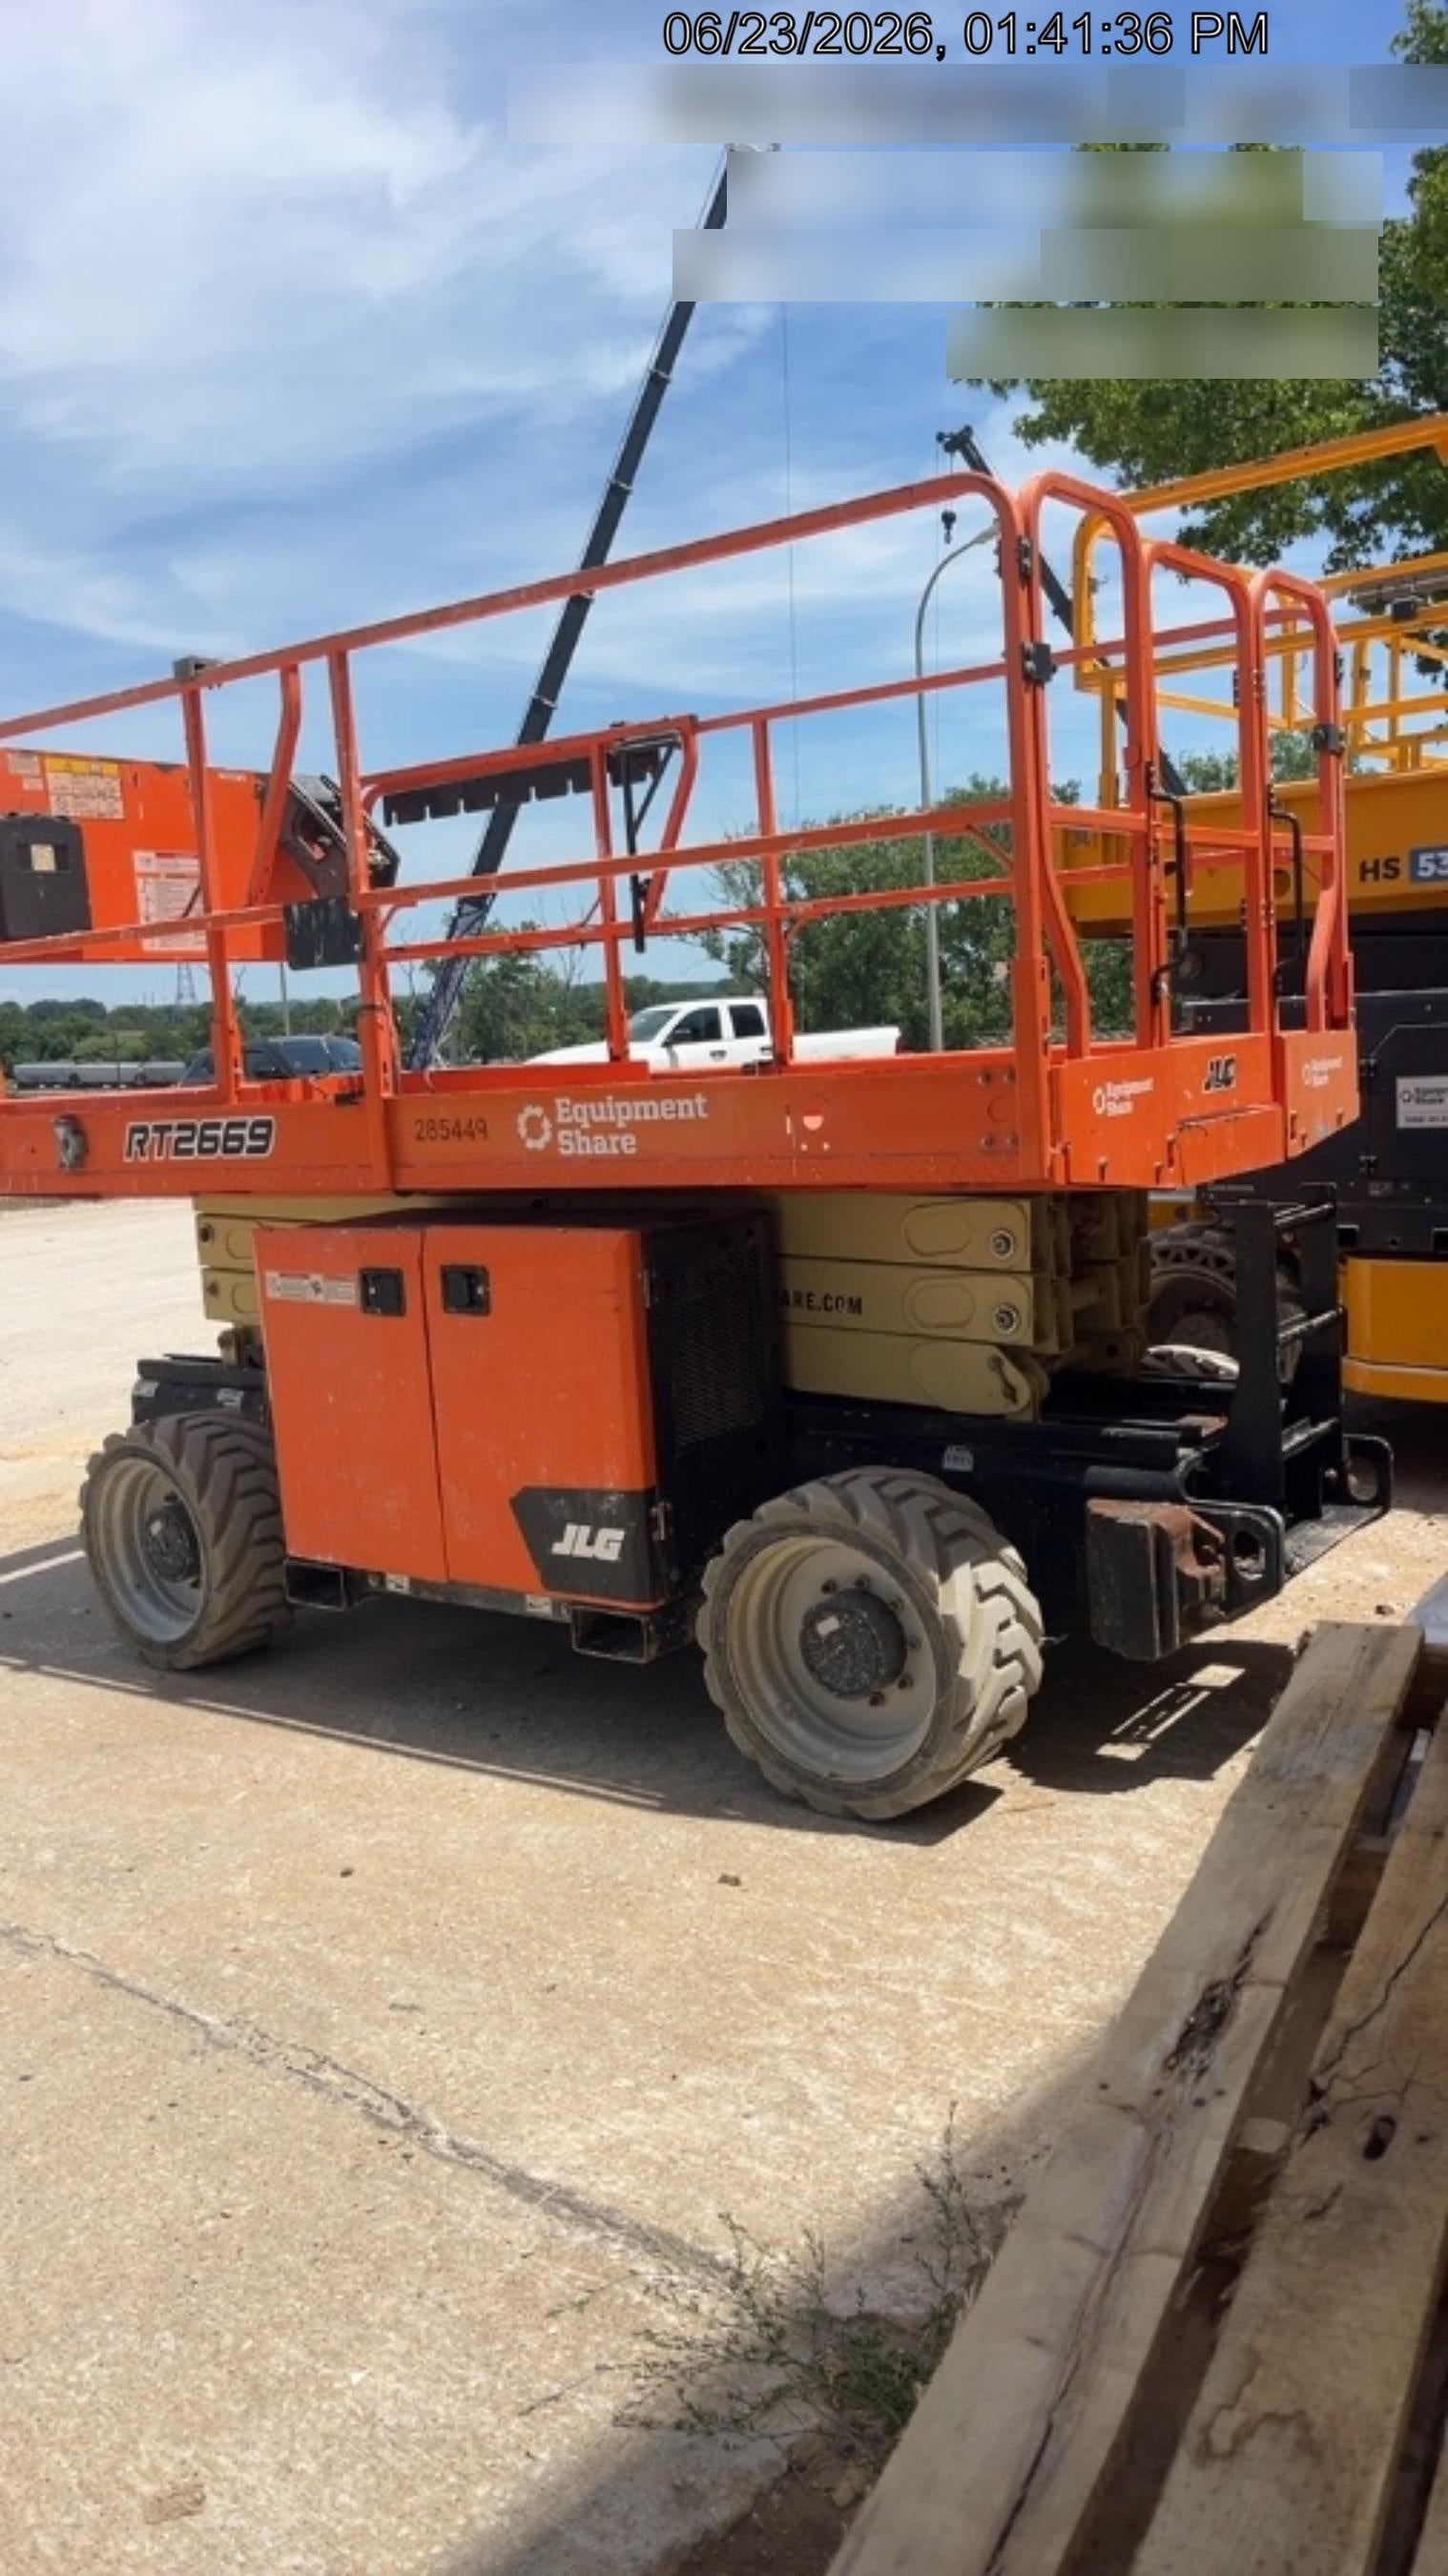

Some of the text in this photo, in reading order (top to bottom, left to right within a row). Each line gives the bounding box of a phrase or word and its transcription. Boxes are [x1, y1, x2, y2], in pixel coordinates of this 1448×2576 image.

[1359, 857, 1400, 883] HS
[555, 1093, 709, 1127] Equipment
[123, 1115, 275, 1162] RT2669
[414, 1117, 488, 1142] 285449
[557, 1130, 638, 1155] Share
[780, 1290, 863, 1316] ARE.COM
[551, 1521, 626, 1562] JLG
